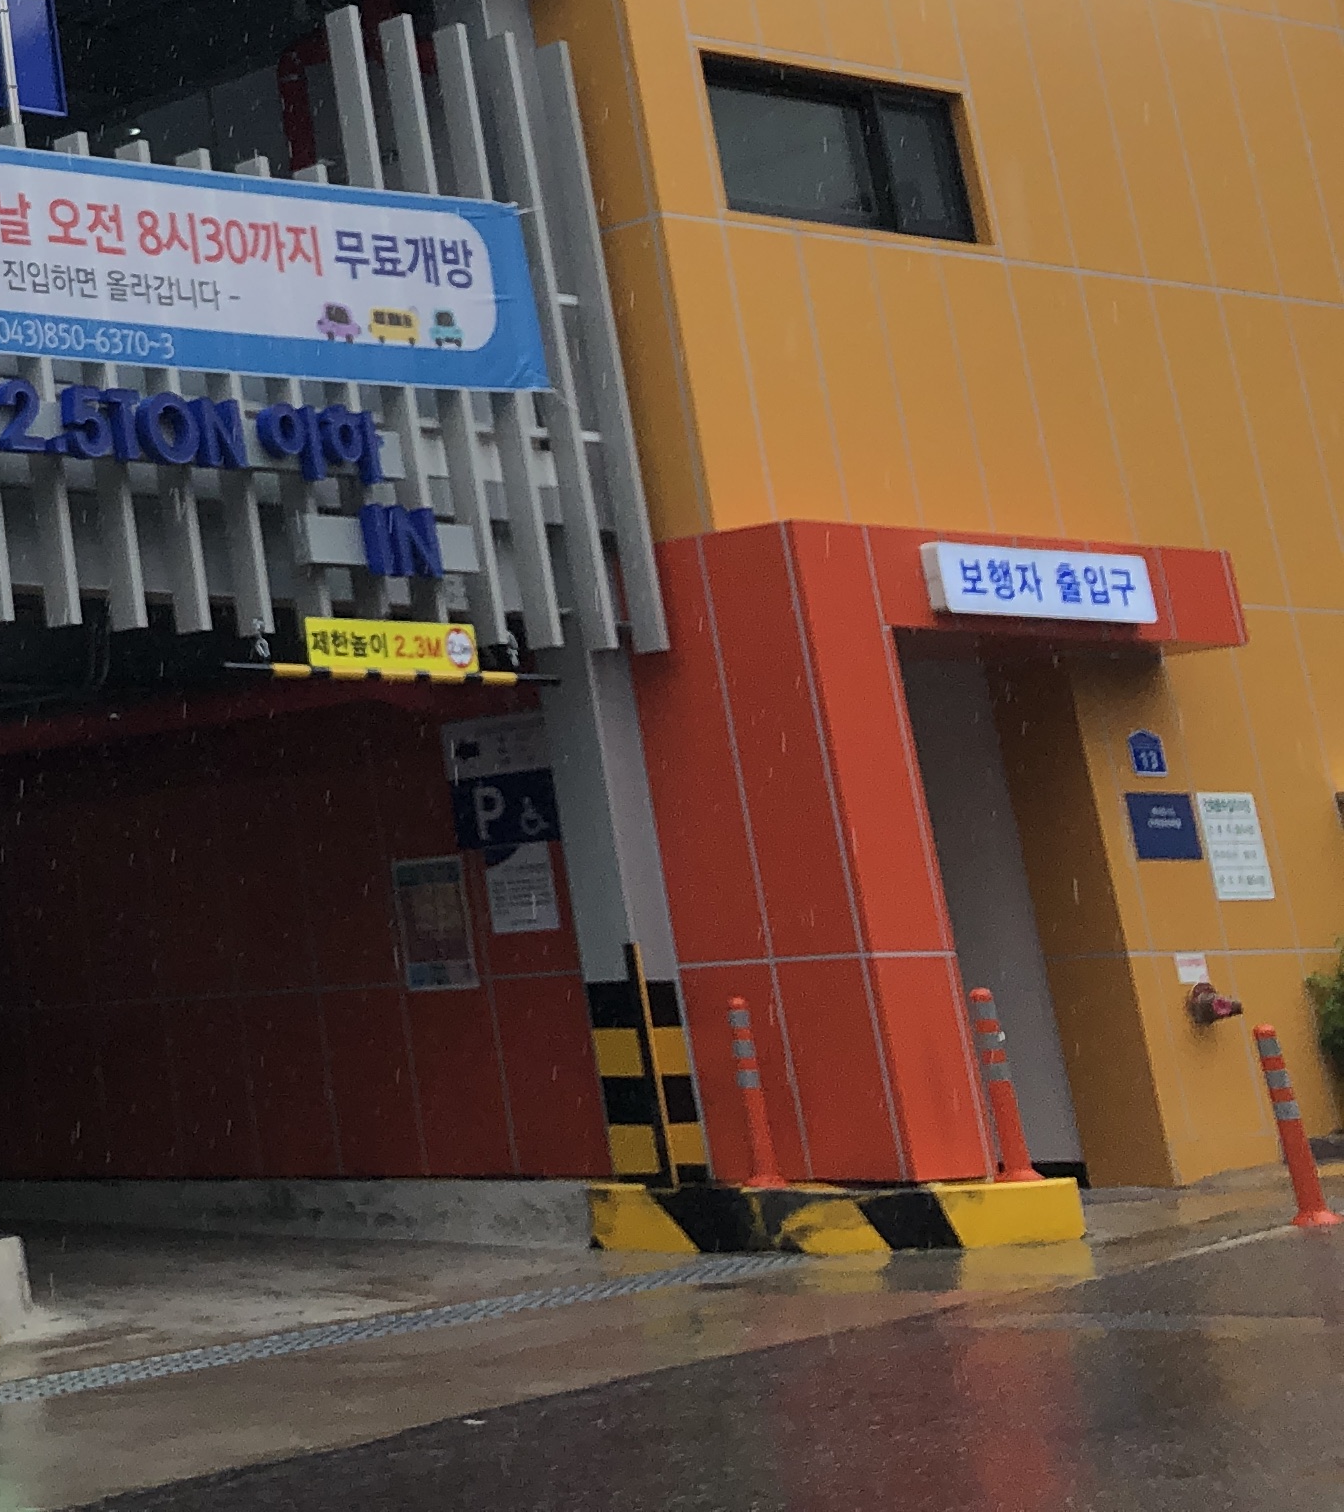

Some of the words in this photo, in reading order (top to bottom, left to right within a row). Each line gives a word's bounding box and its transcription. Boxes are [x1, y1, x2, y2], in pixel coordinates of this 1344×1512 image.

[49, 197, 126, 257] 오전
[140, 209, 324, 278] 8시30까지
[334, 228, 473, 291] 무료개방
[3, 257, 99, 300] 진입하면
[106, 270, 221, 311] 올라갑니다
[360, 503, 444, 579] IN
[961, 558, 1043, 602] 보행자
[1055, 561, 1136, 607] 출입구
[311, 630, 389, 659] 제한높이
[472, 784, 506, 841] P
